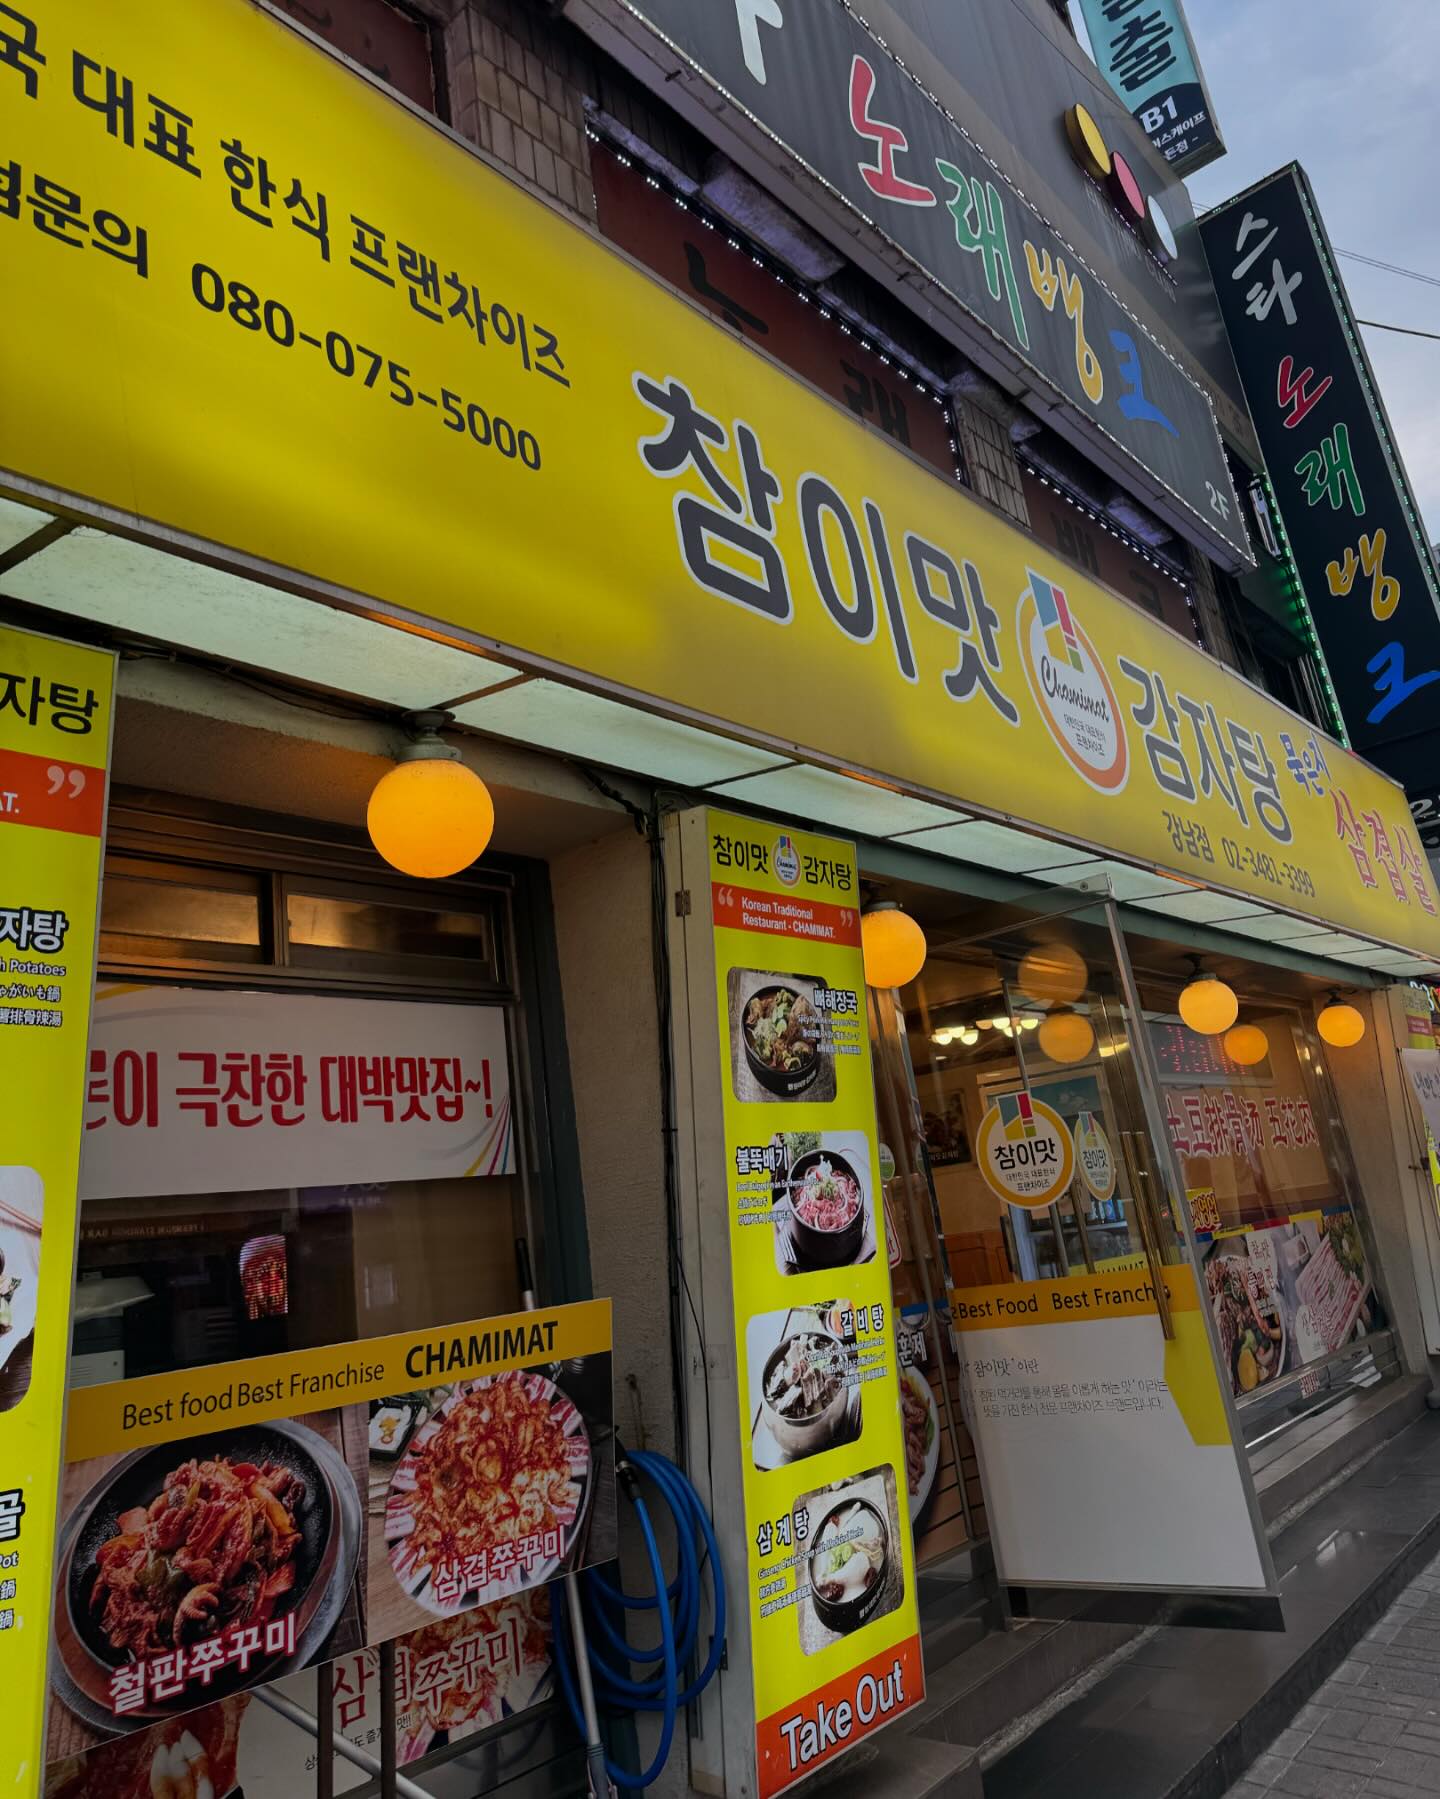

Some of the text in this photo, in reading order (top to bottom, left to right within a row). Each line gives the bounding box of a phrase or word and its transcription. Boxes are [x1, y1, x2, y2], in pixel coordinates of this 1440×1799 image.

[1140, 96, 1178, 133] B1
[72, 49, 202, 178] 대표
[220, 138, 330, 262] 한식
[349, 213, 570, 388] 프랜차이즈
[192, 263, 541, 470] 080-075-5000
[1207, 479, 1231, 521] 2F
[632, 371, 1294, 845] 참이맛 감자탕
[713, 834, 853, 892] 참이맛 감자탕
[1162, 810, 1317, 898] 강남점 02-3481-3399
[1330, 788, 1438, 918] 삼겹살
[741, 896, 814, 919] Korean Traditional
[743, 911, 787, 931] Restaurant
[9, 959, 67, 977] Potatoes
[813, 988, 858, 1014] 뼈해장국
[175, 1052, 307, 1128] 극찬한
[319, 1056, 494, 1123] 대박맛집~!
[994, 1137, 1058, 1171] 참이맛
[1166, 1092, 1319, 1156] 土豆排骨汤 五花肉
[735, 1145, 788, 1175] 불뚝배기
[956, 1302, 991, 1320] Best
[997, 1295, 1039, 1317] Food
[1053, 1290, 1088, 1311] Best
[123, 1320, 558, 1430] Best food Best Franchise CHAMIMAT
[435, 1523, 566, 1602] 삼겹쭈꾸미
[108, 1612, 296, 1714] 철판쭈꾸미
[780, 1661, 905, 1772] Take Out
